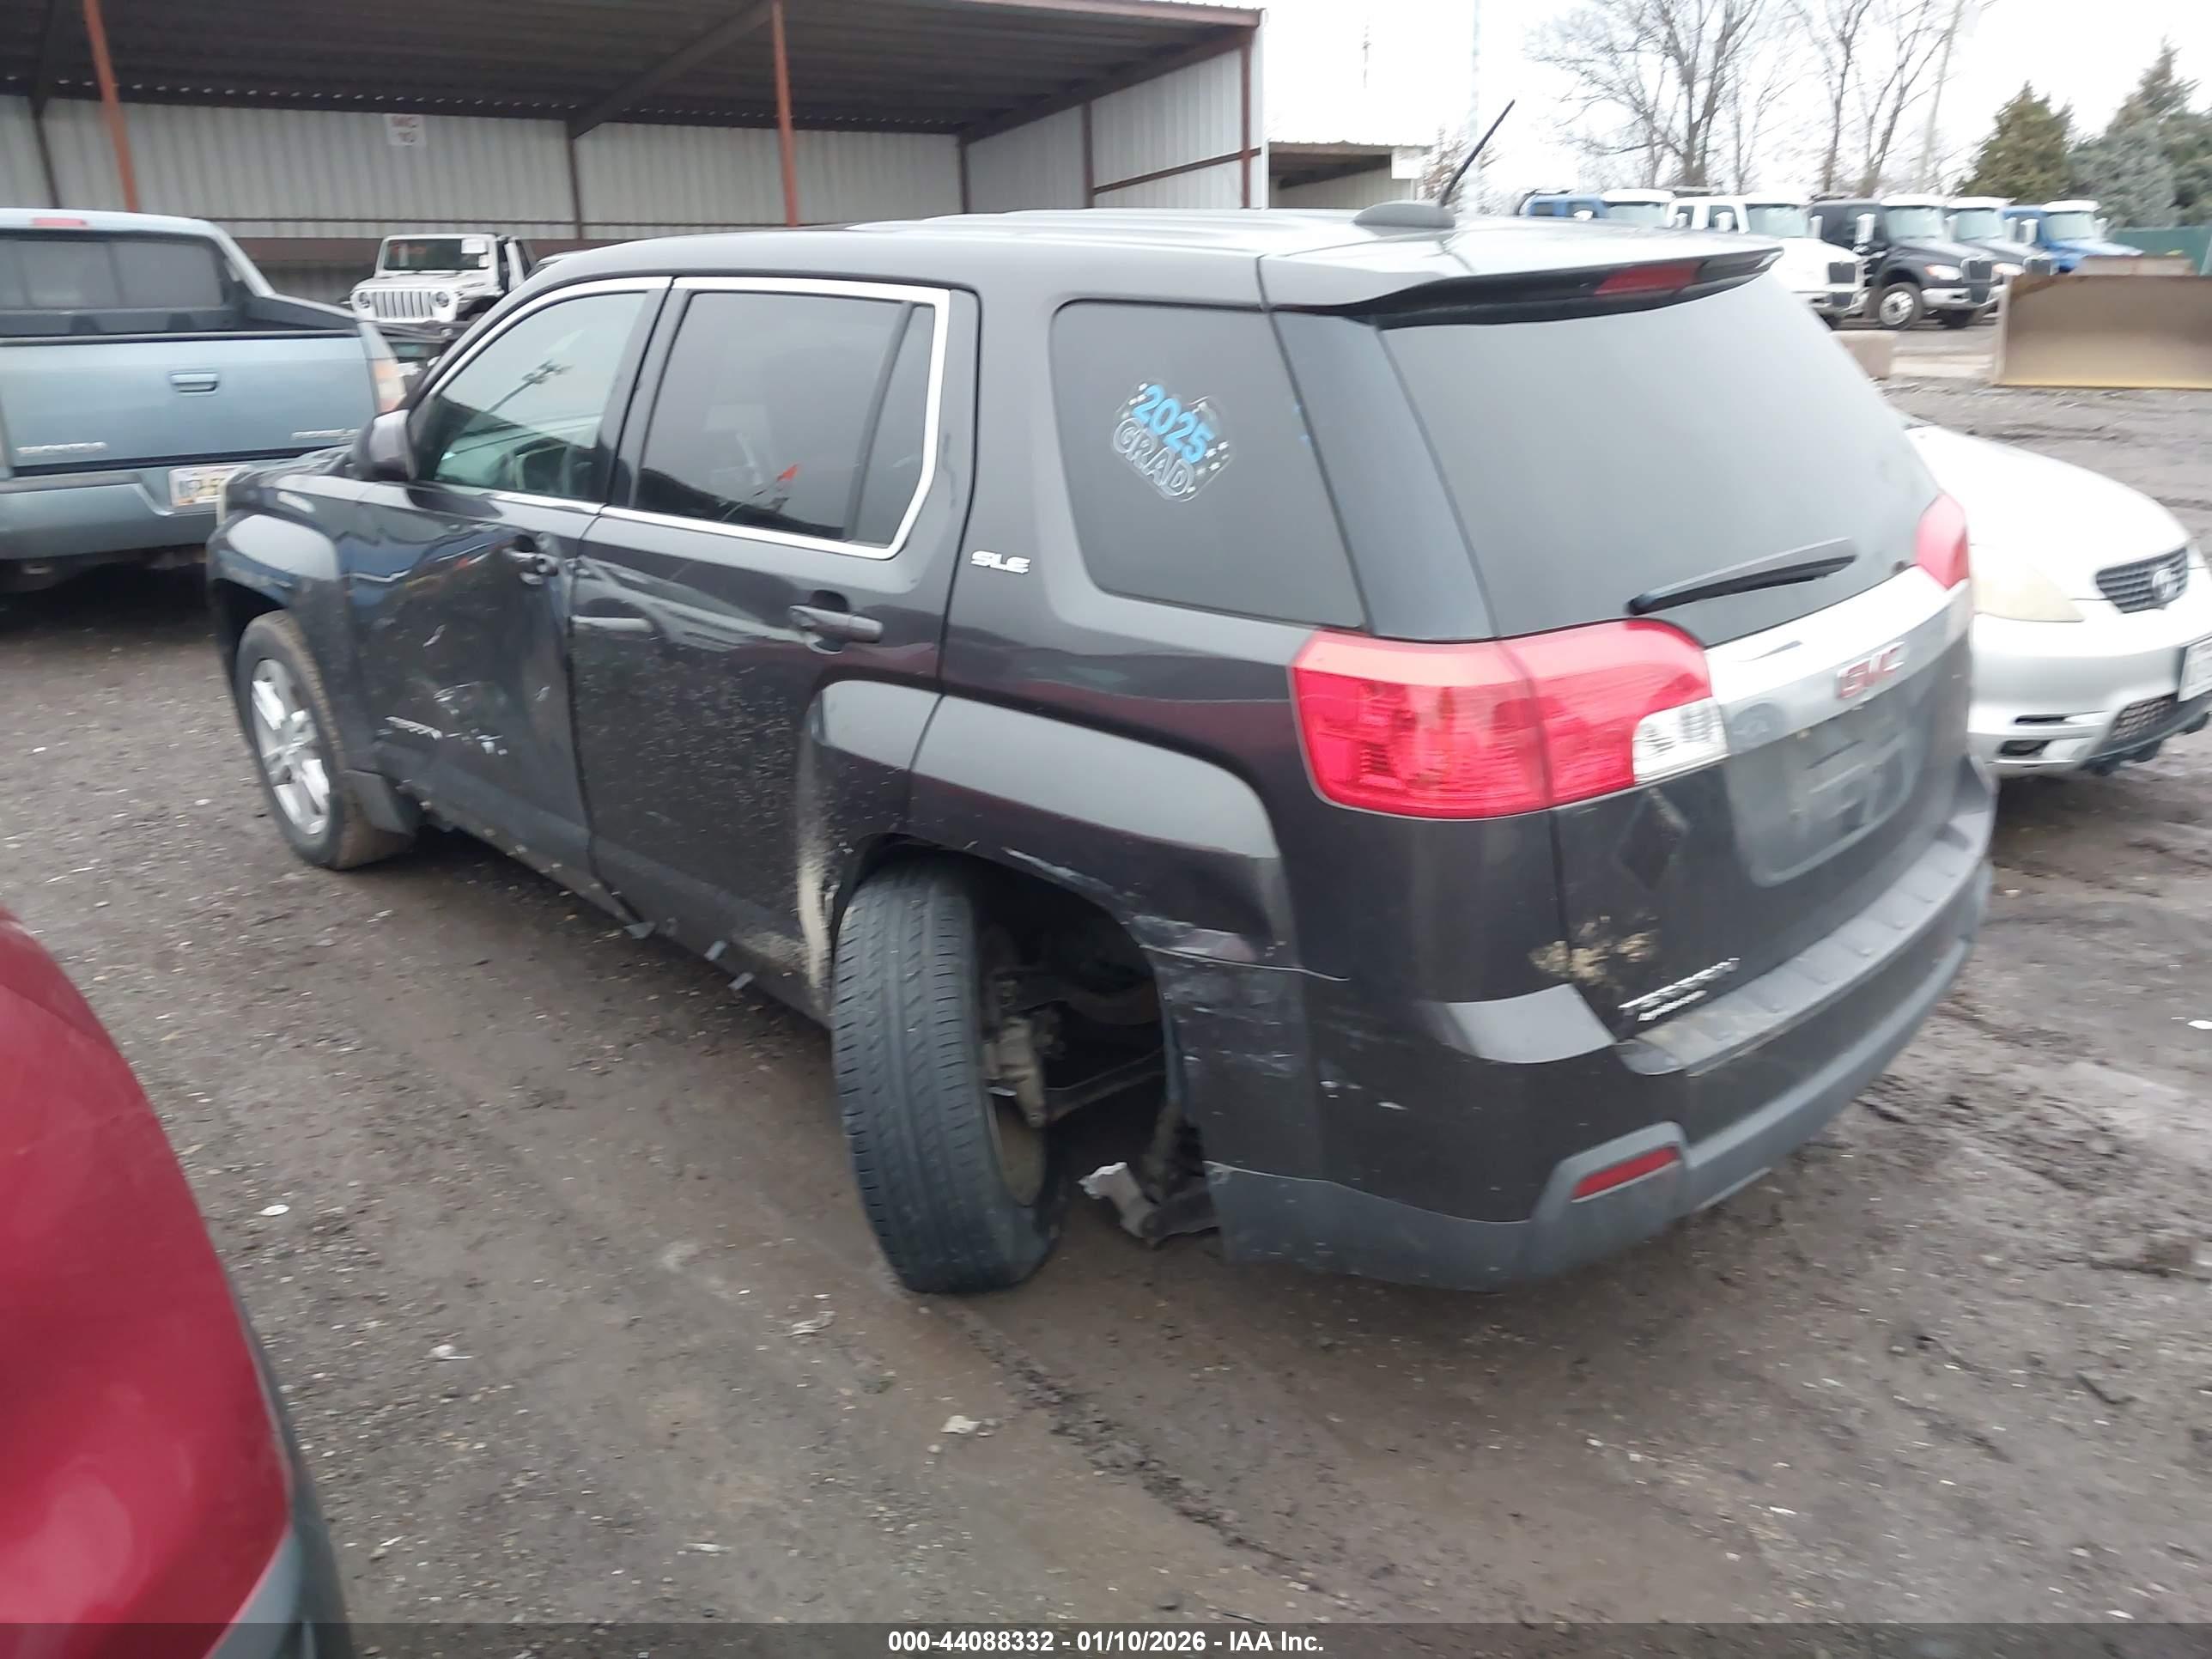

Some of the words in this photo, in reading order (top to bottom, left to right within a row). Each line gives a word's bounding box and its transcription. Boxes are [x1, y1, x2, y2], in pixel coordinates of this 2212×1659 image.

[1112, 416, 1196, 496] GRAD
[1131, 383, 1215, 464] 2025
[969, 550, 1031, 575] SLE
